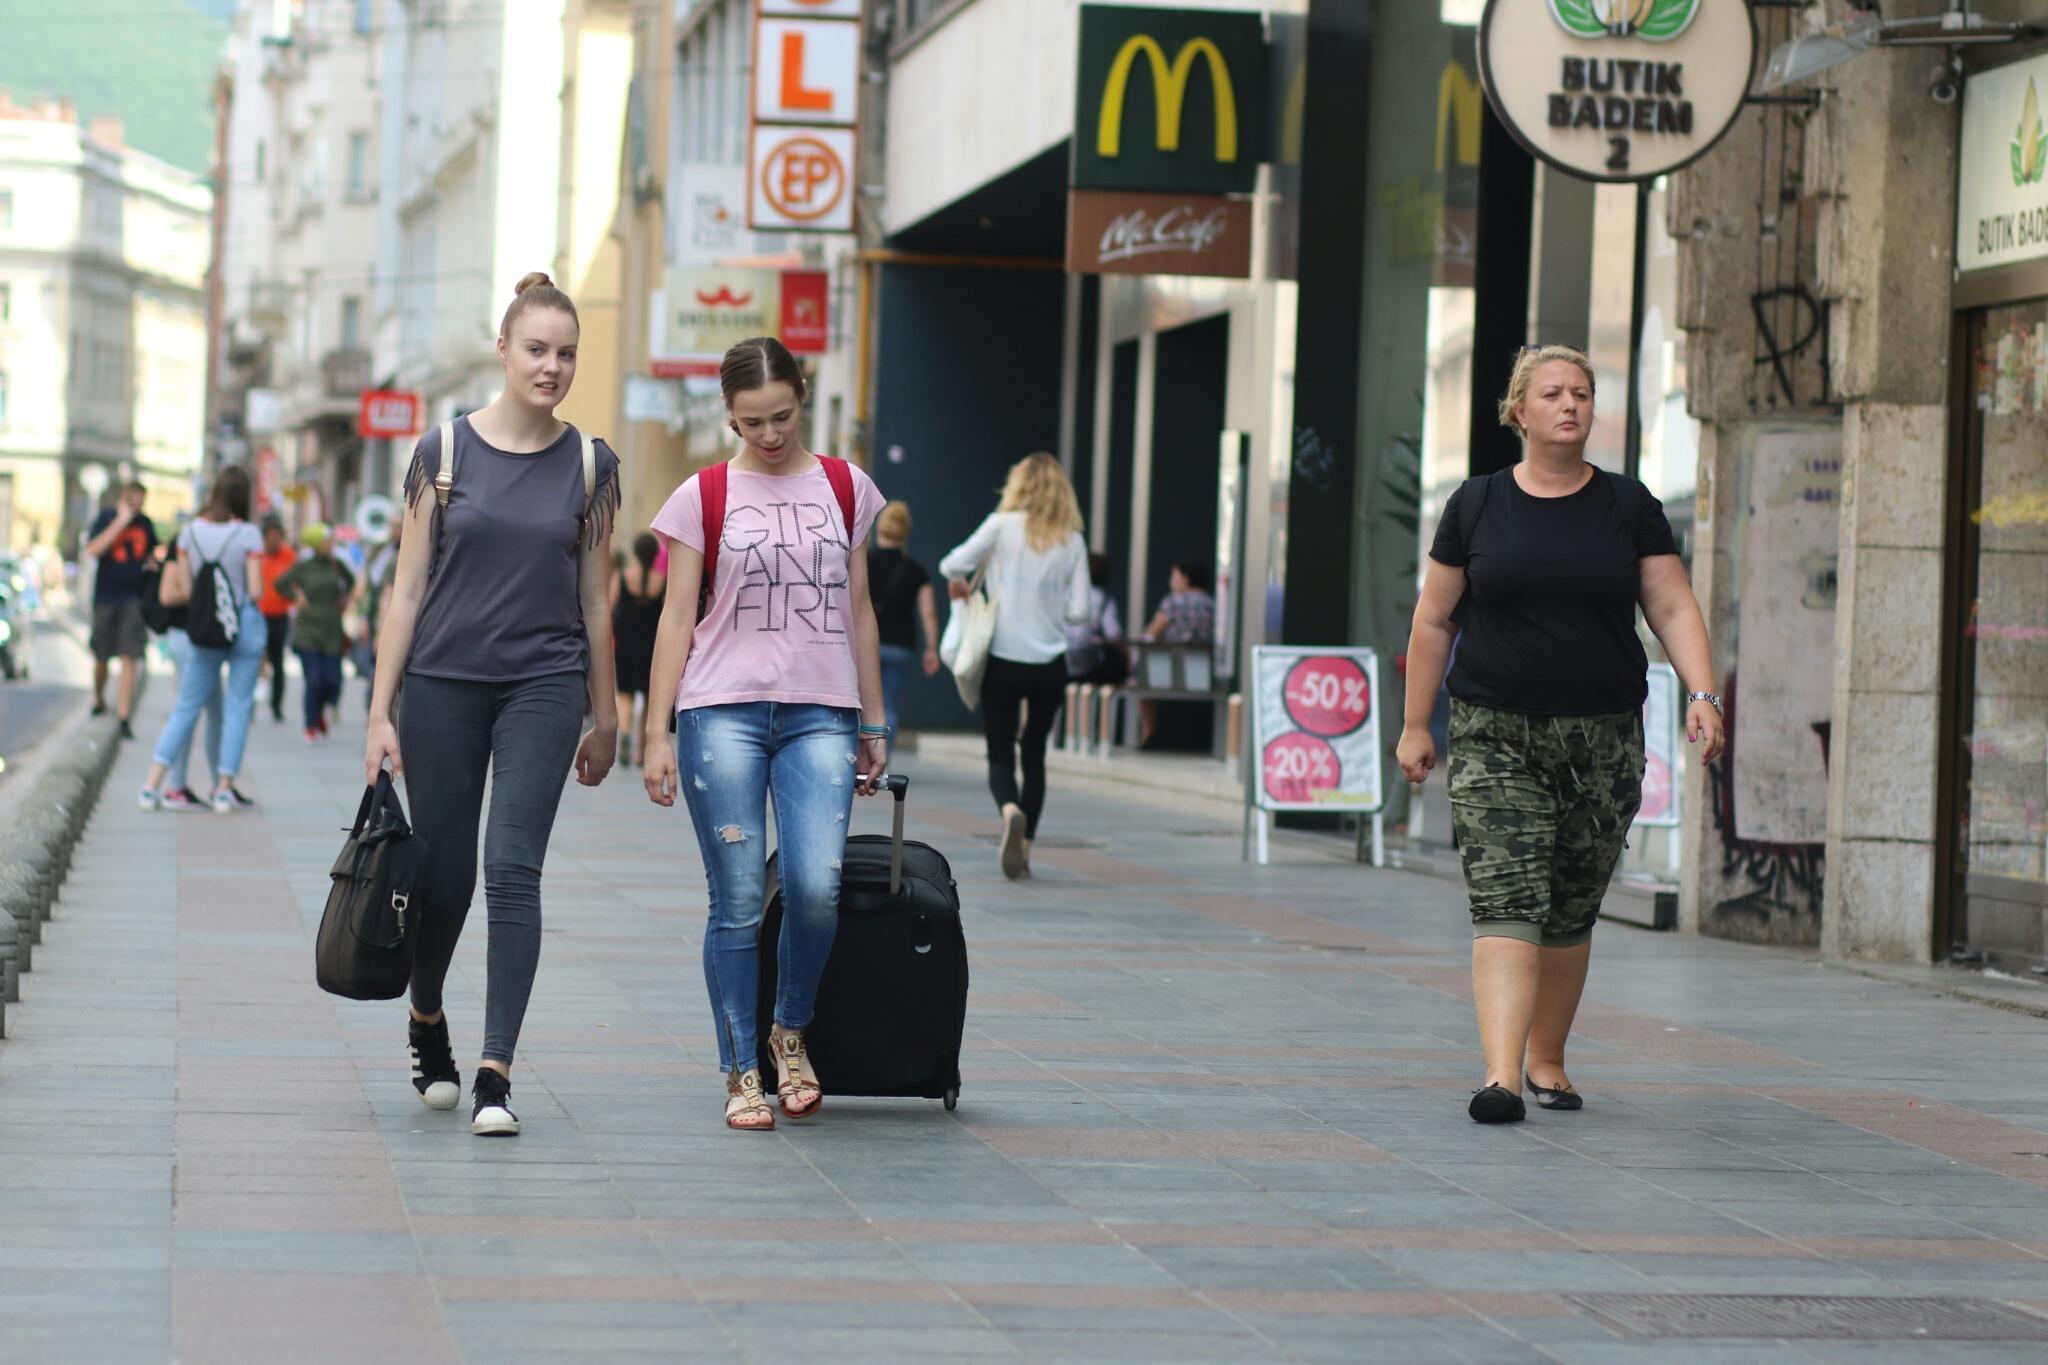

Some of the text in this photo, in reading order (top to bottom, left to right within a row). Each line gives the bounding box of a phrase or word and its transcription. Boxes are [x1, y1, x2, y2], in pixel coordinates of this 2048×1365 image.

[1562, 57, 1683, 96] BUTIK
[1548, 94, 1693, 134] BADEM
[1605, 135, 1630, 169] 2
[782, 154, 832, 203] EP
[1979, 213, 2015, 254] BUTIK
[743, 539, 848, 589] AND
[734, 582, 846, 634] FIRE
